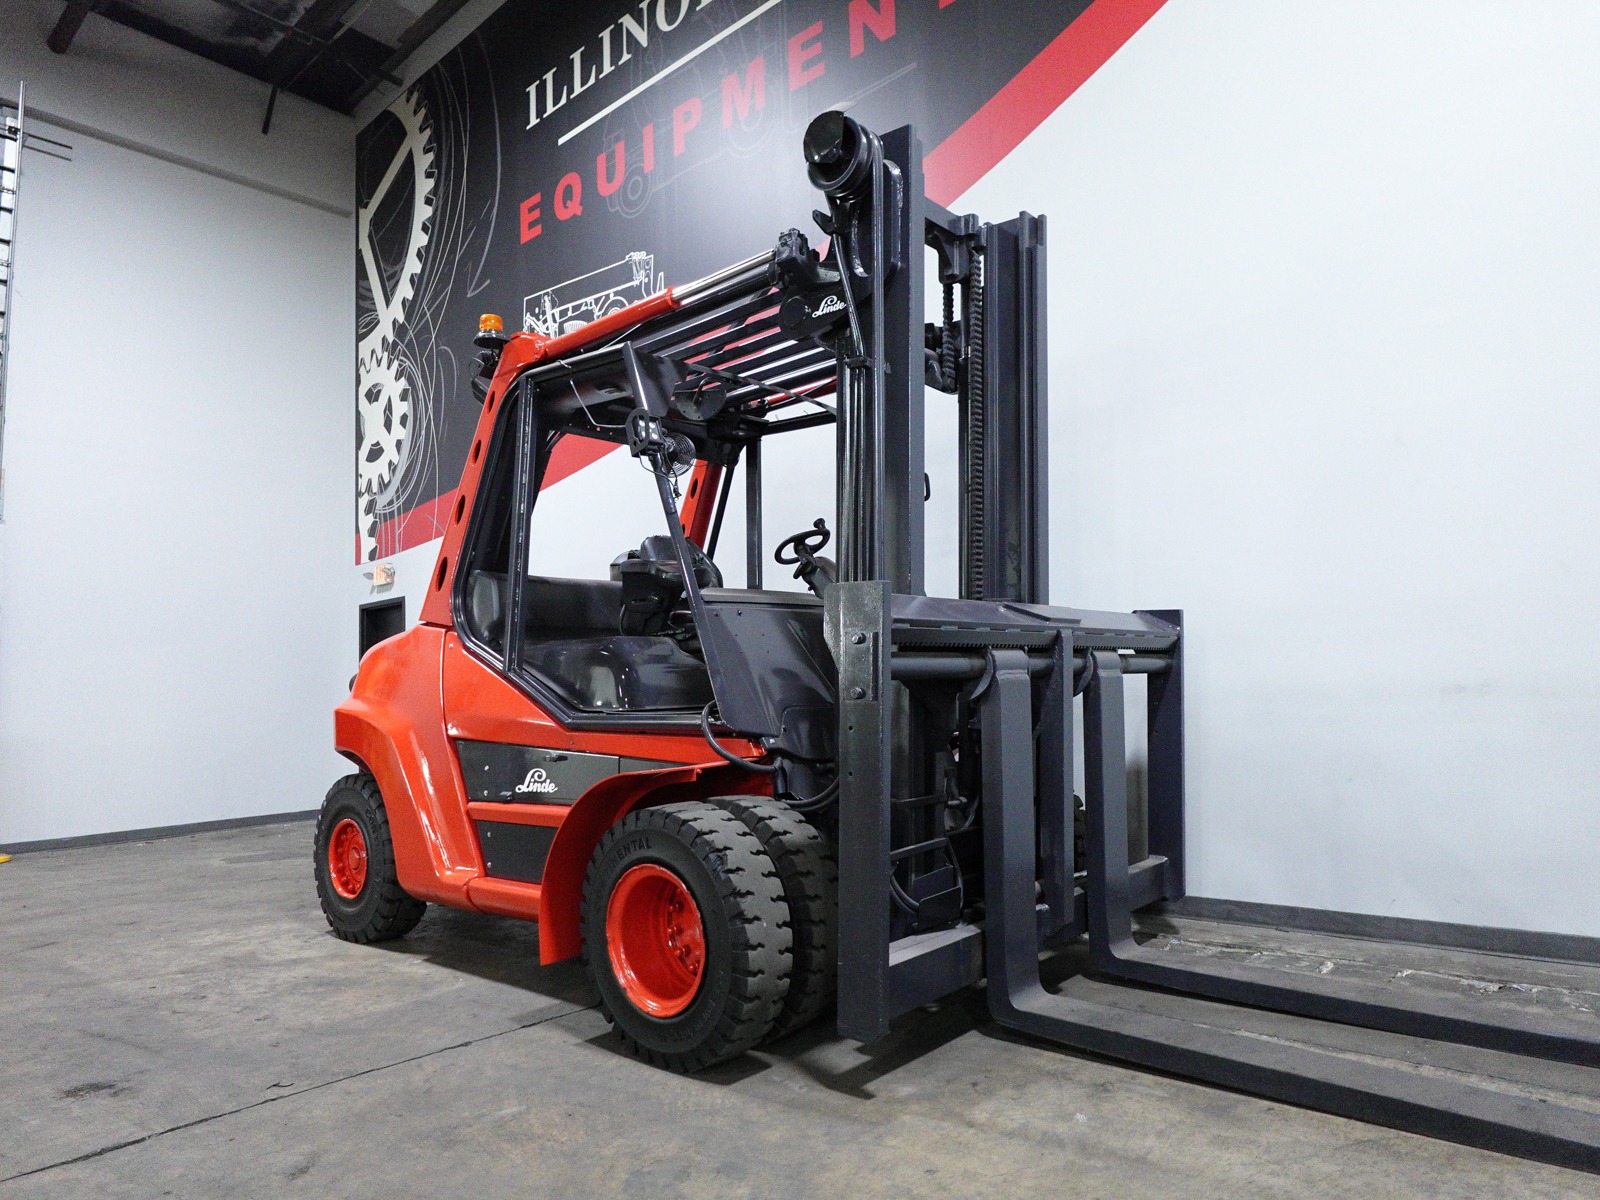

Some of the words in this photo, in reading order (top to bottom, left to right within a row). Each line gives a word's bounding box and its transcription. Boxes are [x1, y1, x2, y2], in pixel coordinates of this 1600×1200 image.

[525, 0, 713, 131] ILLINO
[519, 0, 957, 245] EQUIPMEN
[811, 295, 847, 318] Linde
[515, 768, 558, 793] Linde
